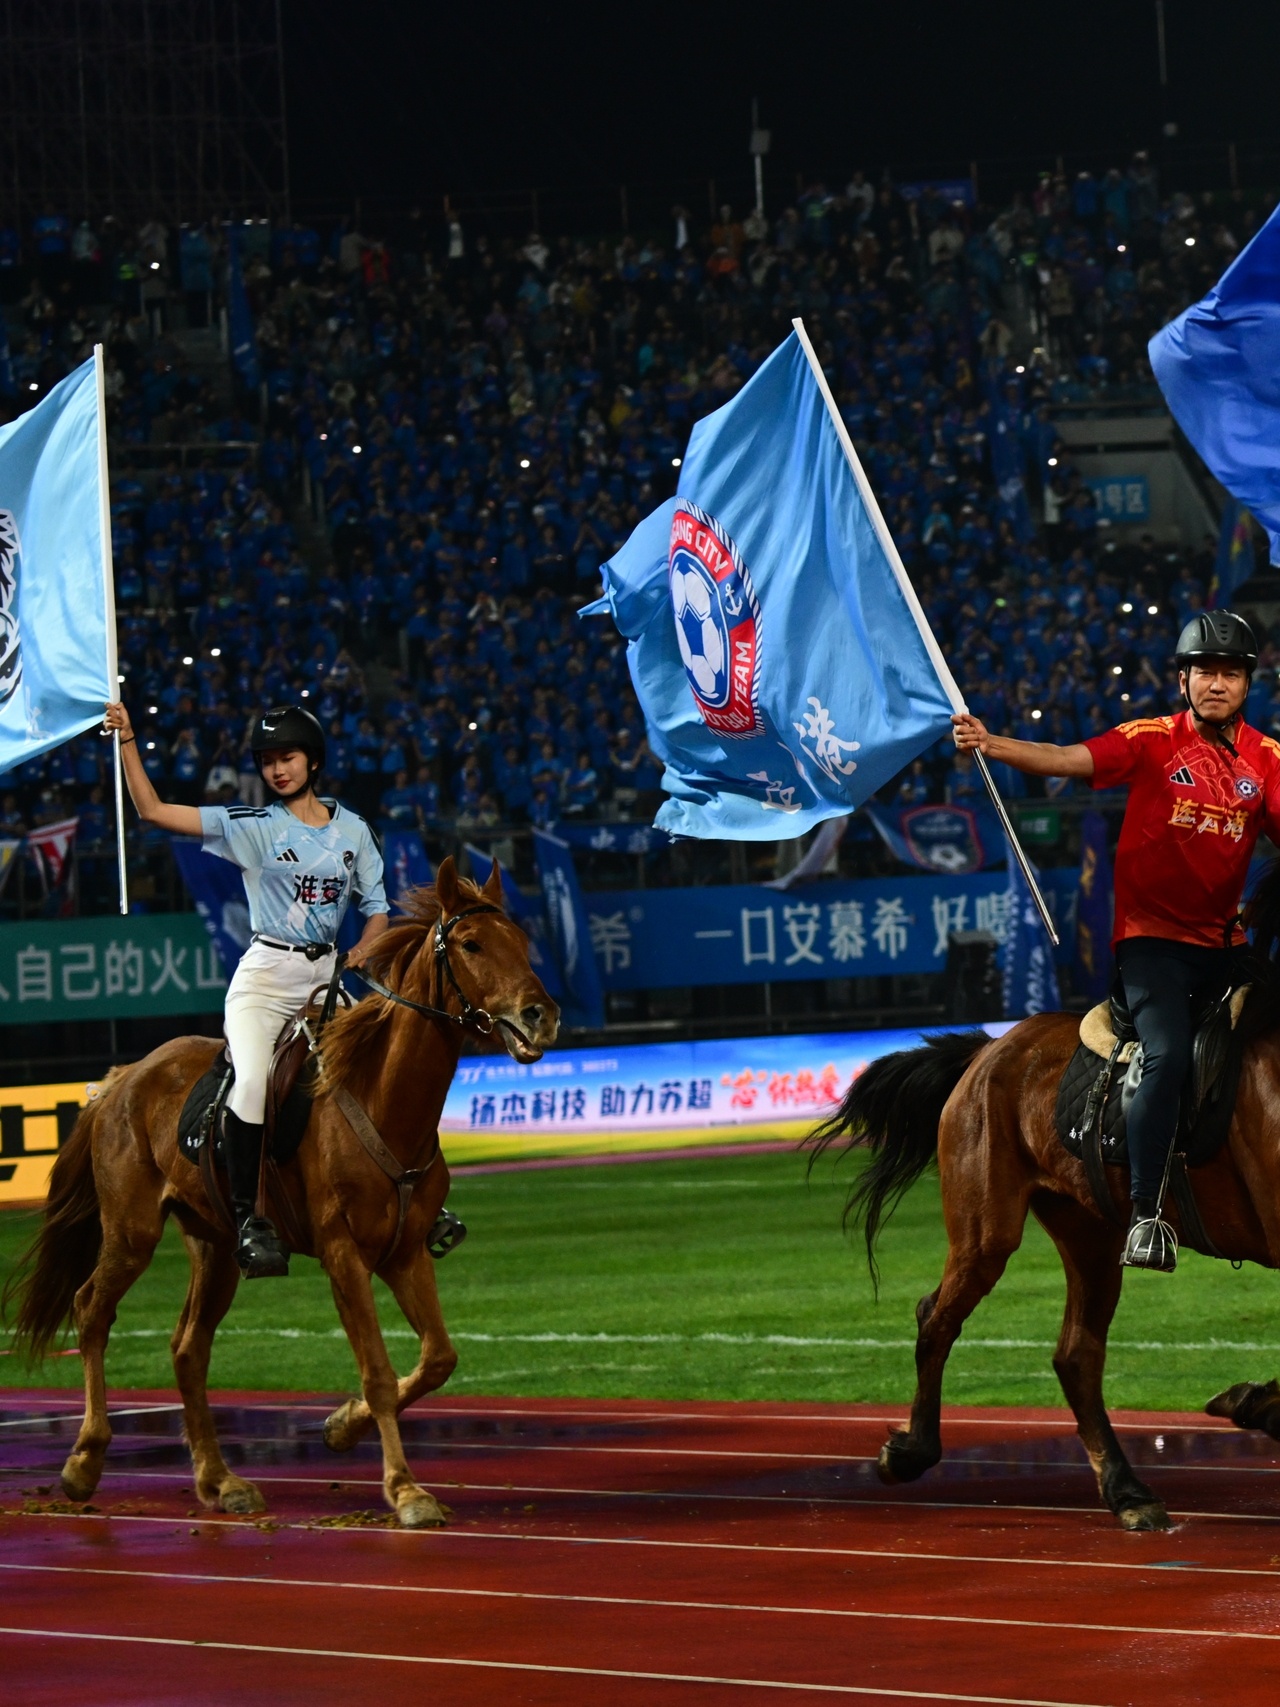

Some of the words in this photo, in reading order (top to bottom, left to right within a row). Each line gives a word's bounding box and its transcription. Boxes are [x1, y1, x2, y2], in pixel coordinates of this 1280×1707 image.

[695, 530, 728, 573] CITY
[735, 641, 751, 702] TEAM
[293, 874, 345, 906] 淮安
[694, 897, 908, 966] 一口安慕希
[0, 936, 229, 1003] 自己的火山
[470, 1087, 588, 1127] 扬杰科技
[599, 1078, 713, 1117] 助力苏超
